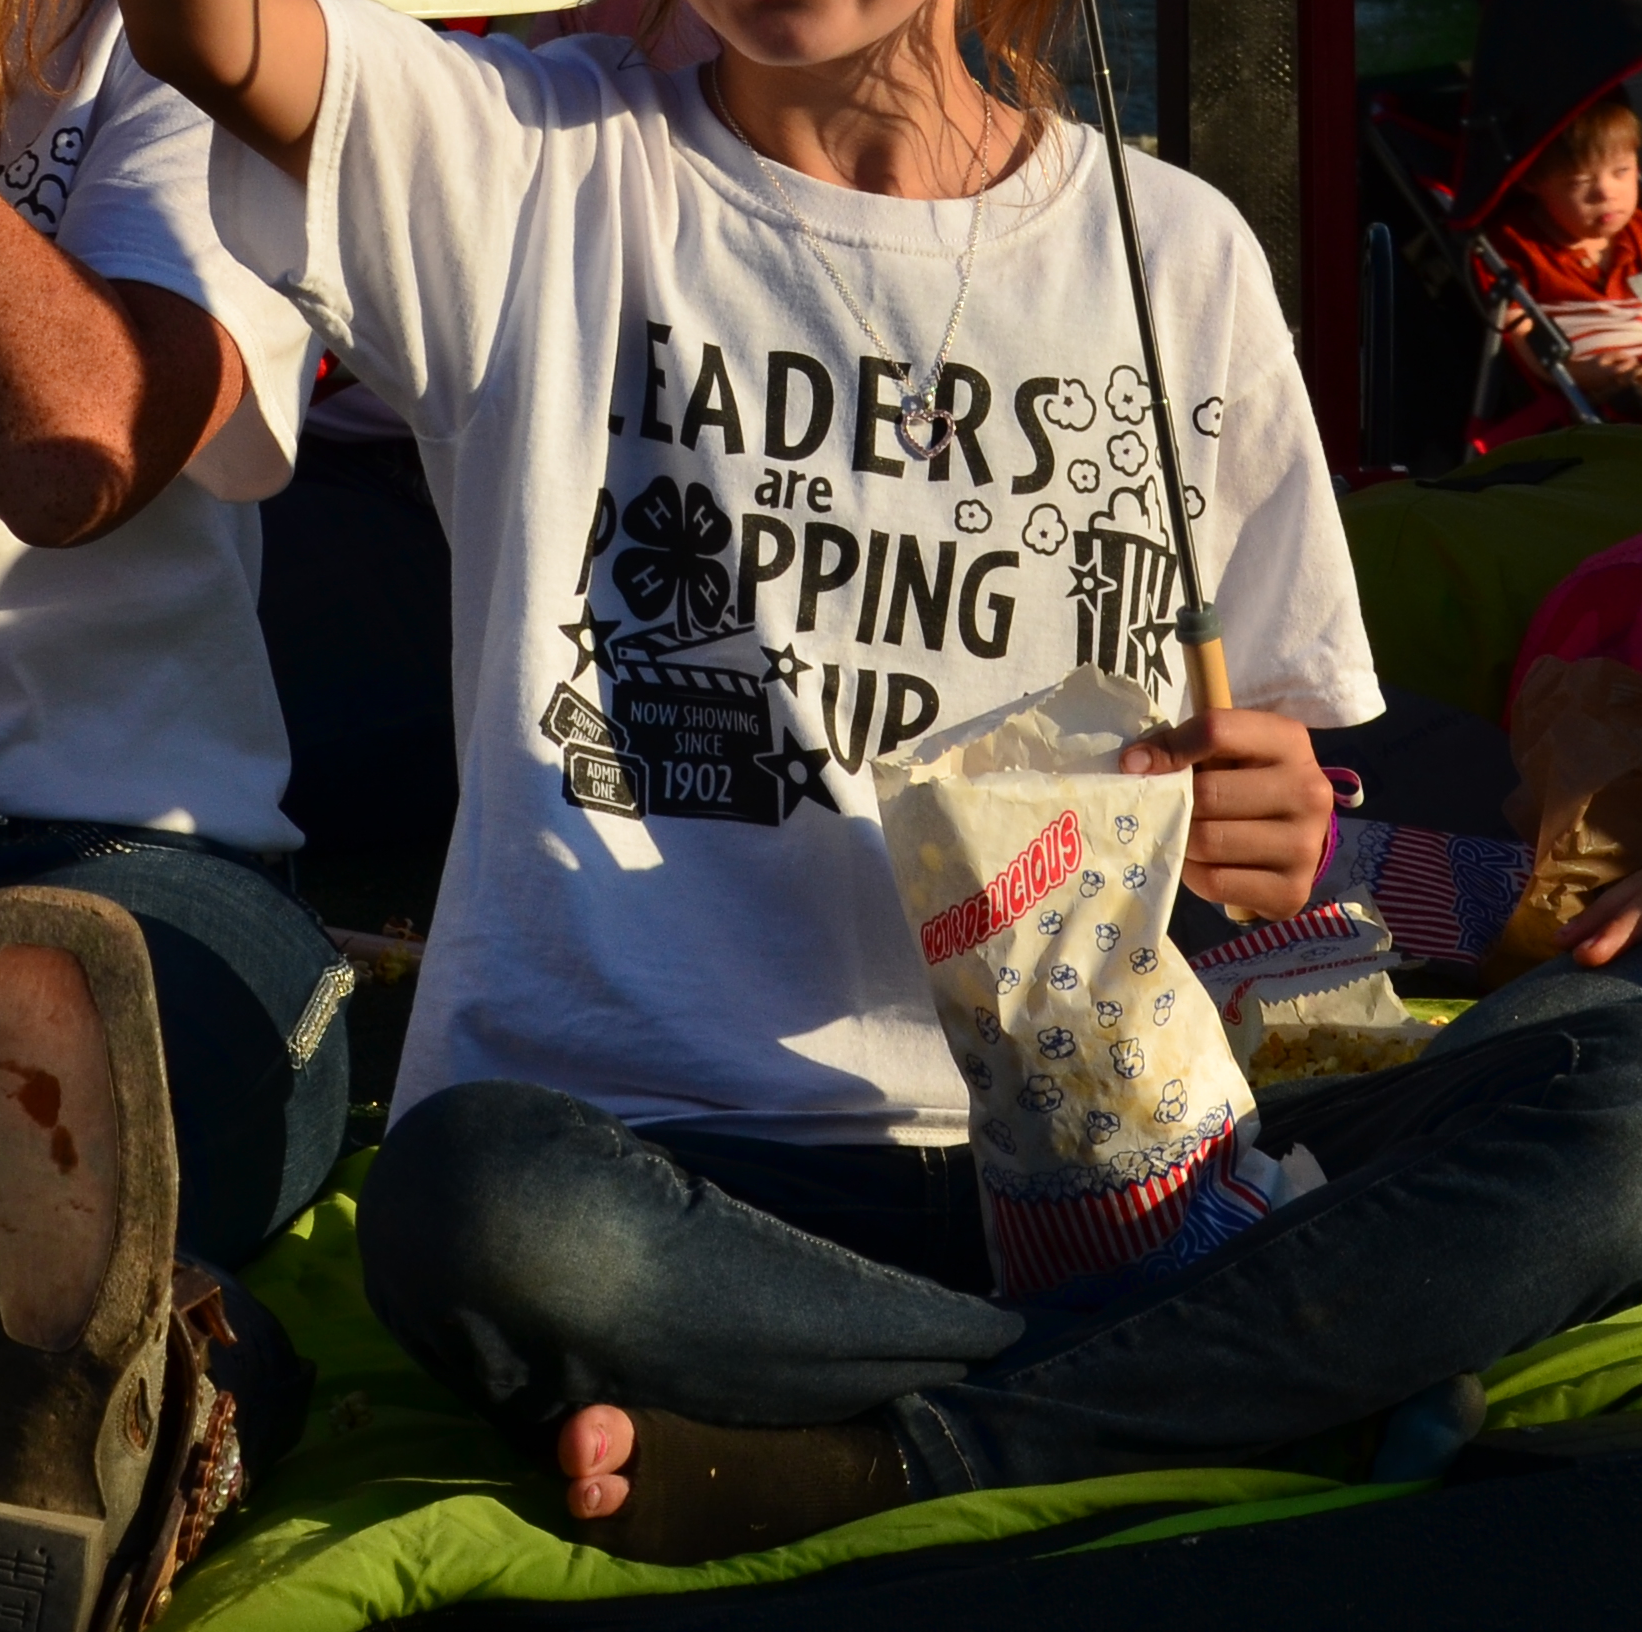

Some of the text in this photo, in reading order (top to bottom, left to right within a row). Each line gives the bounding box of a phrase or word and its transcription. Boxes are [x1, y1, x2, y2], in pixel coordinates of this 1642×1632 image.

[608, 320, 1060, 496] EADERS
[755, 465, 834, 514] are
[567, 707, 604, 742] ADMIT
[630, 700, 759, 736] NOW SHOWING
[822, 662, 941, 776] UP
[674, 730, 724, 758] SINCE
[586, 761, 621, 784] ADMIT
[592, 780, 616, 801] ONE
[661, 760, 733, 804] 1902
[963, 810, 1081, 948] DELICIOUS
